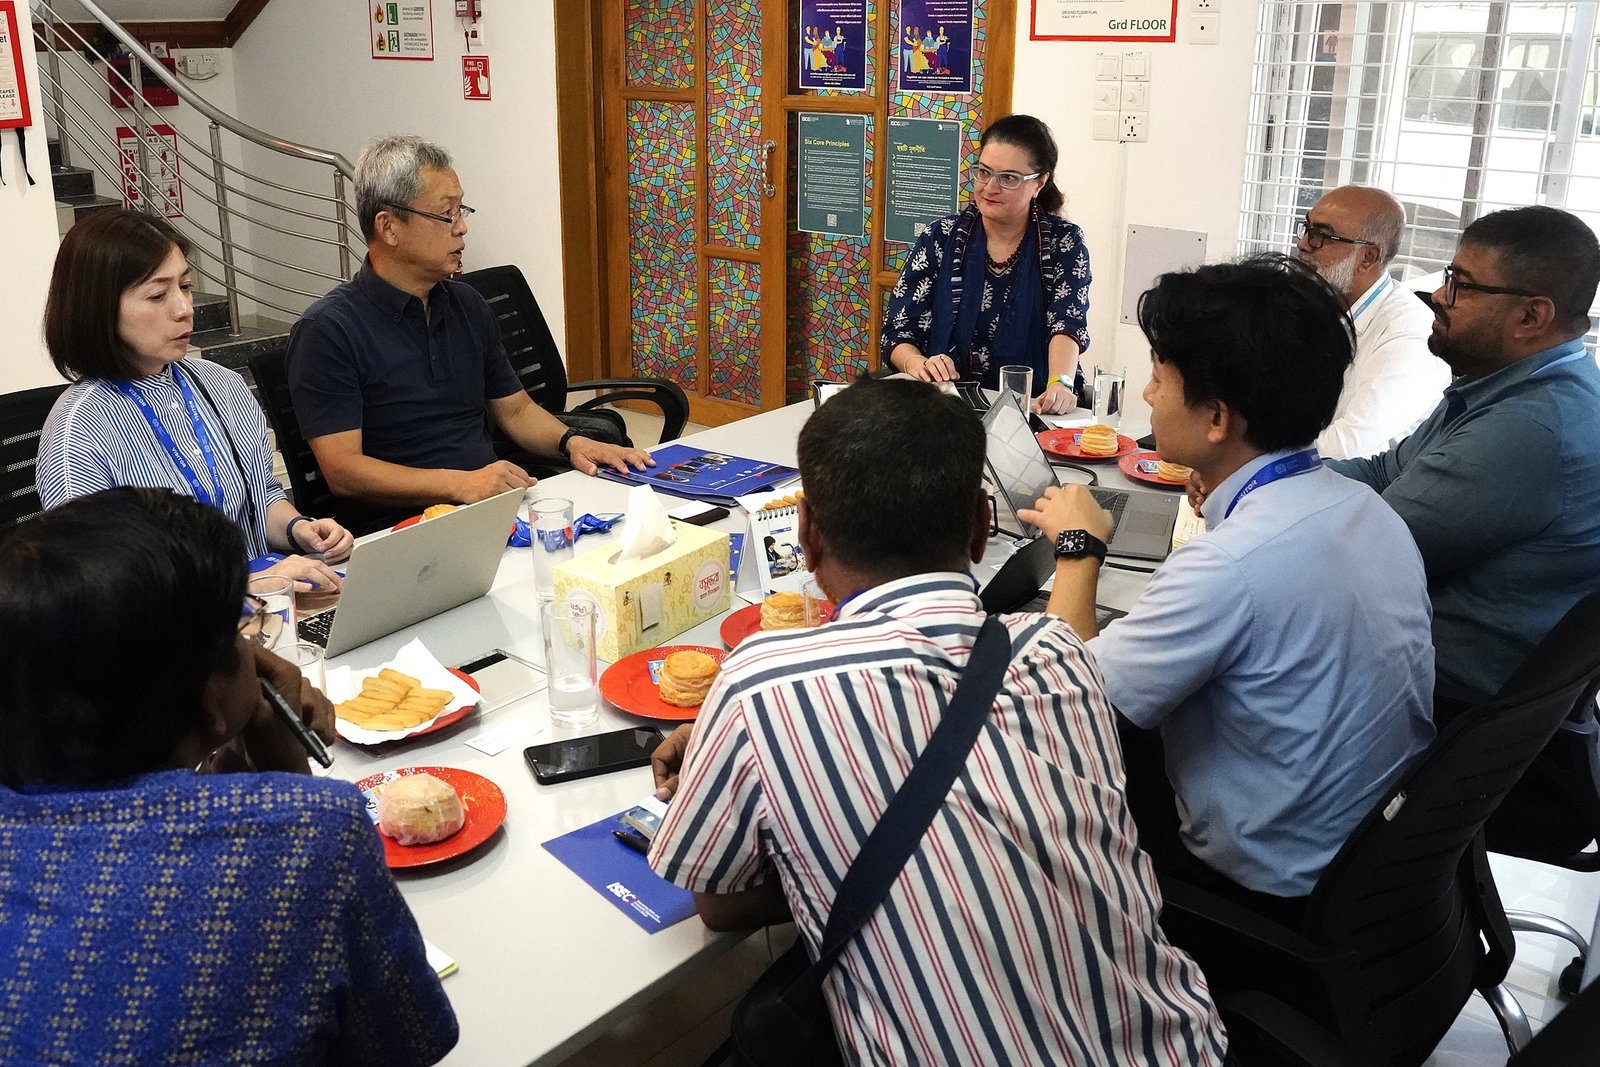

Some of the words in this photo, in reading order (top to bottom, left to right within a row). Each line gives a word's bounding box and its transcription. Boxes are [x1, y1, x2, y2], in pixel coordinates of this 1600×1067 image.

[1109, 19, 1127, 30] Grd
[1130, 20, 1166, 30] FLOOR
[128, 387, 147, 407] VISITOR
[189, 401, 199, 421] VISITOR
[172, 447, 187, 468] VISITOR
[606, 882, 636, 903] ISEC
